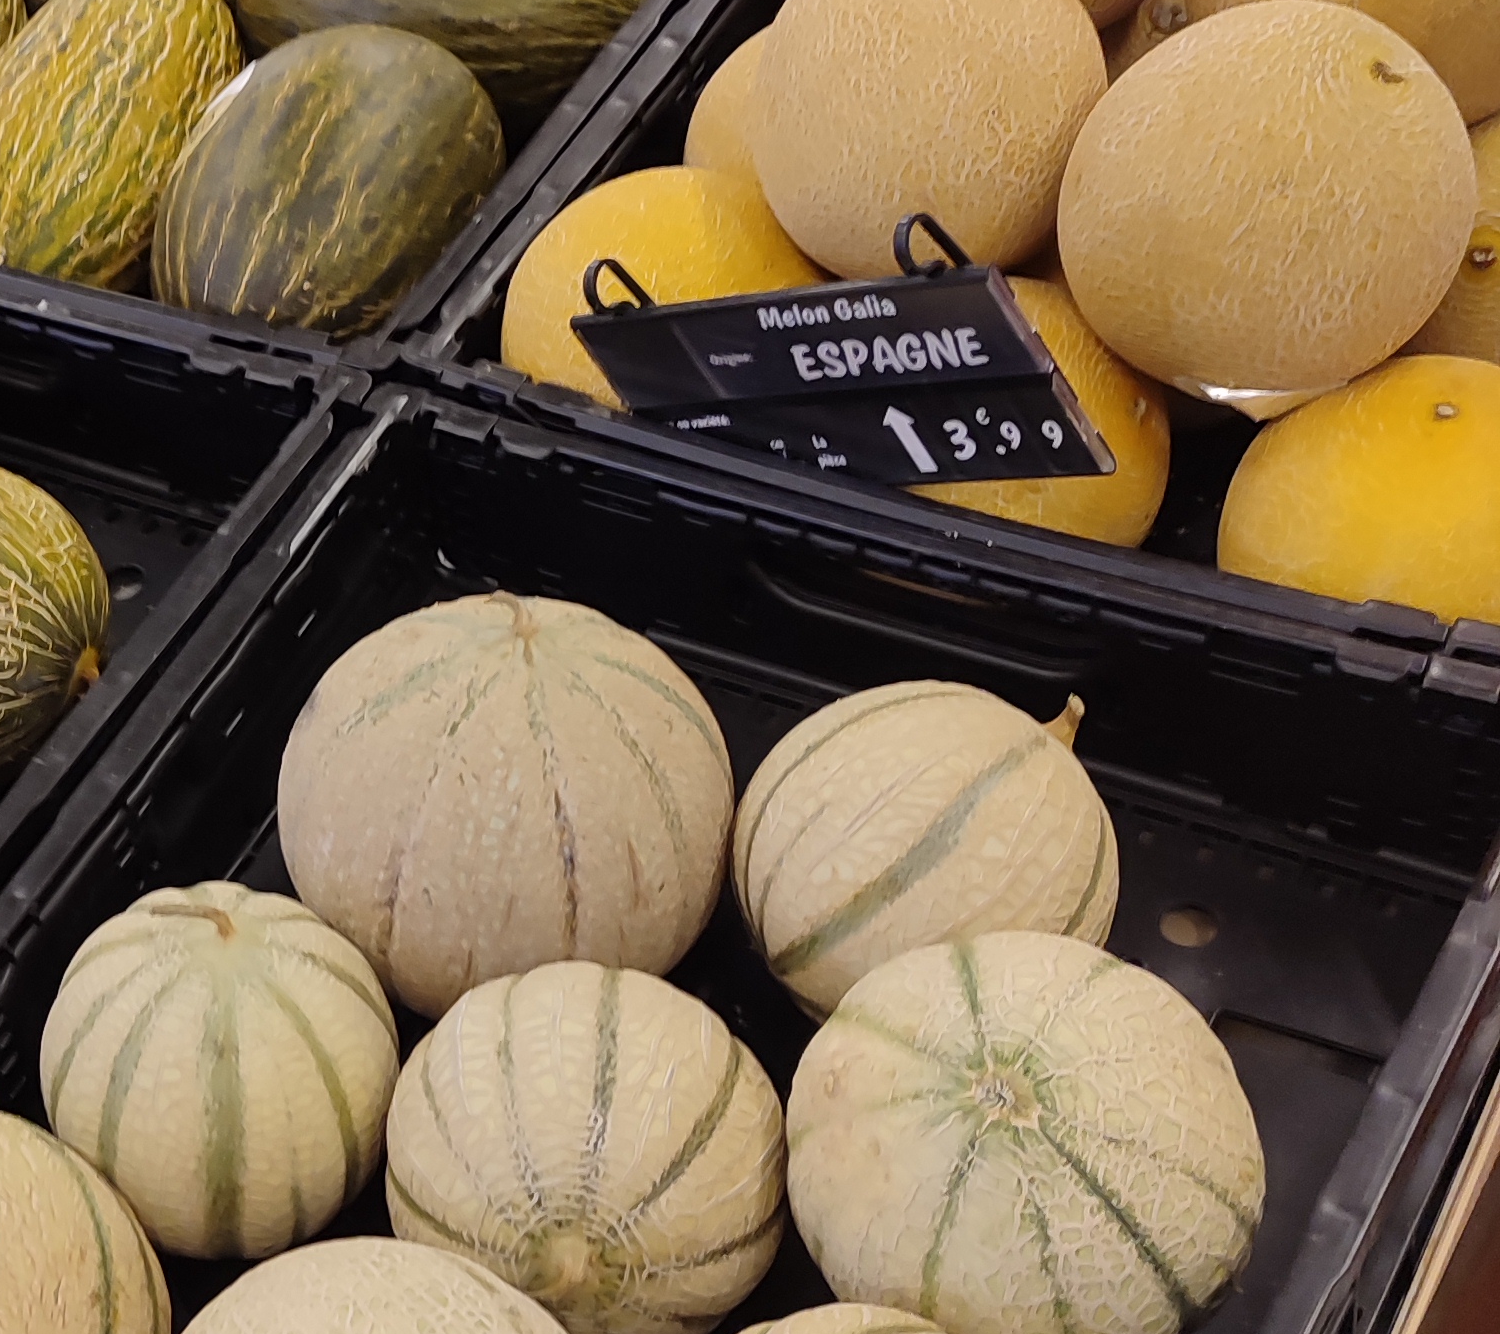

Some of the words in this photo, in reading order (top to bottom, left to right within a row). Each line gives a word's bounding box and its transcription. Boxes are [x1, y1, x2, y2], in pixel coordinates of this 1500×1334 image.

[756, 303, 830, 331] Melon
[833, 293, 898, 322] Galia
[789, 325, 990, 383] ESPAGNE
